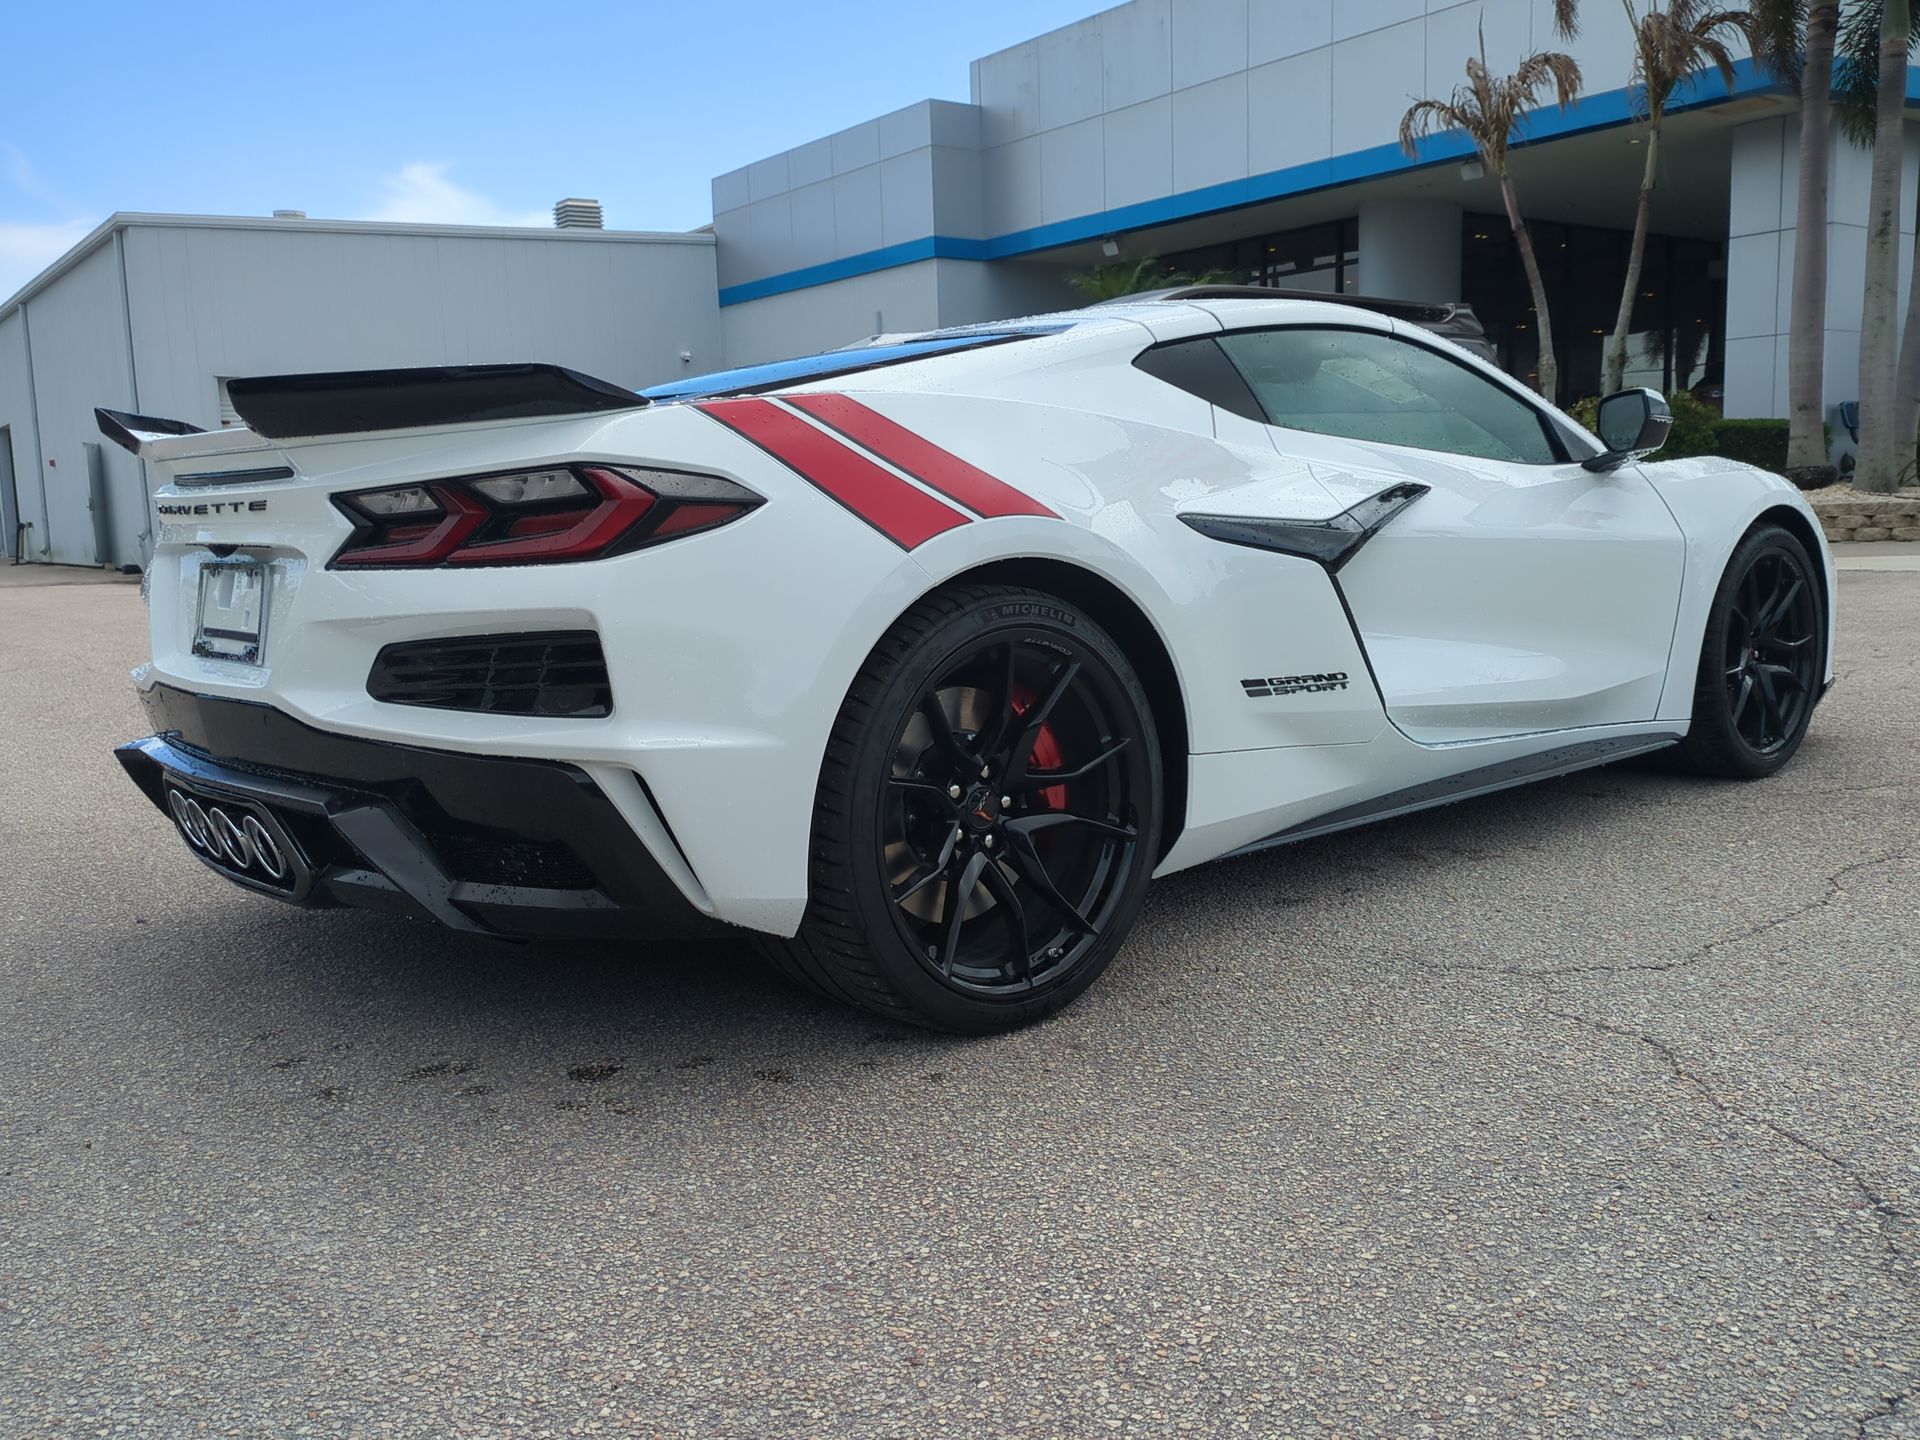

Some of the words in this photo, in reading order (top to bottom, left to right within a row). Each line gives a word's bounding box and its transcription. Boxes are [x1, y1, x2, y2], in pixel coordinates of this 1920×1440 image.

[1002, 604, 1073, 624] MICHELIN
[1267, 672, 1348, 686] GRAND
[1273, 681, 1349, 696] SPORT
